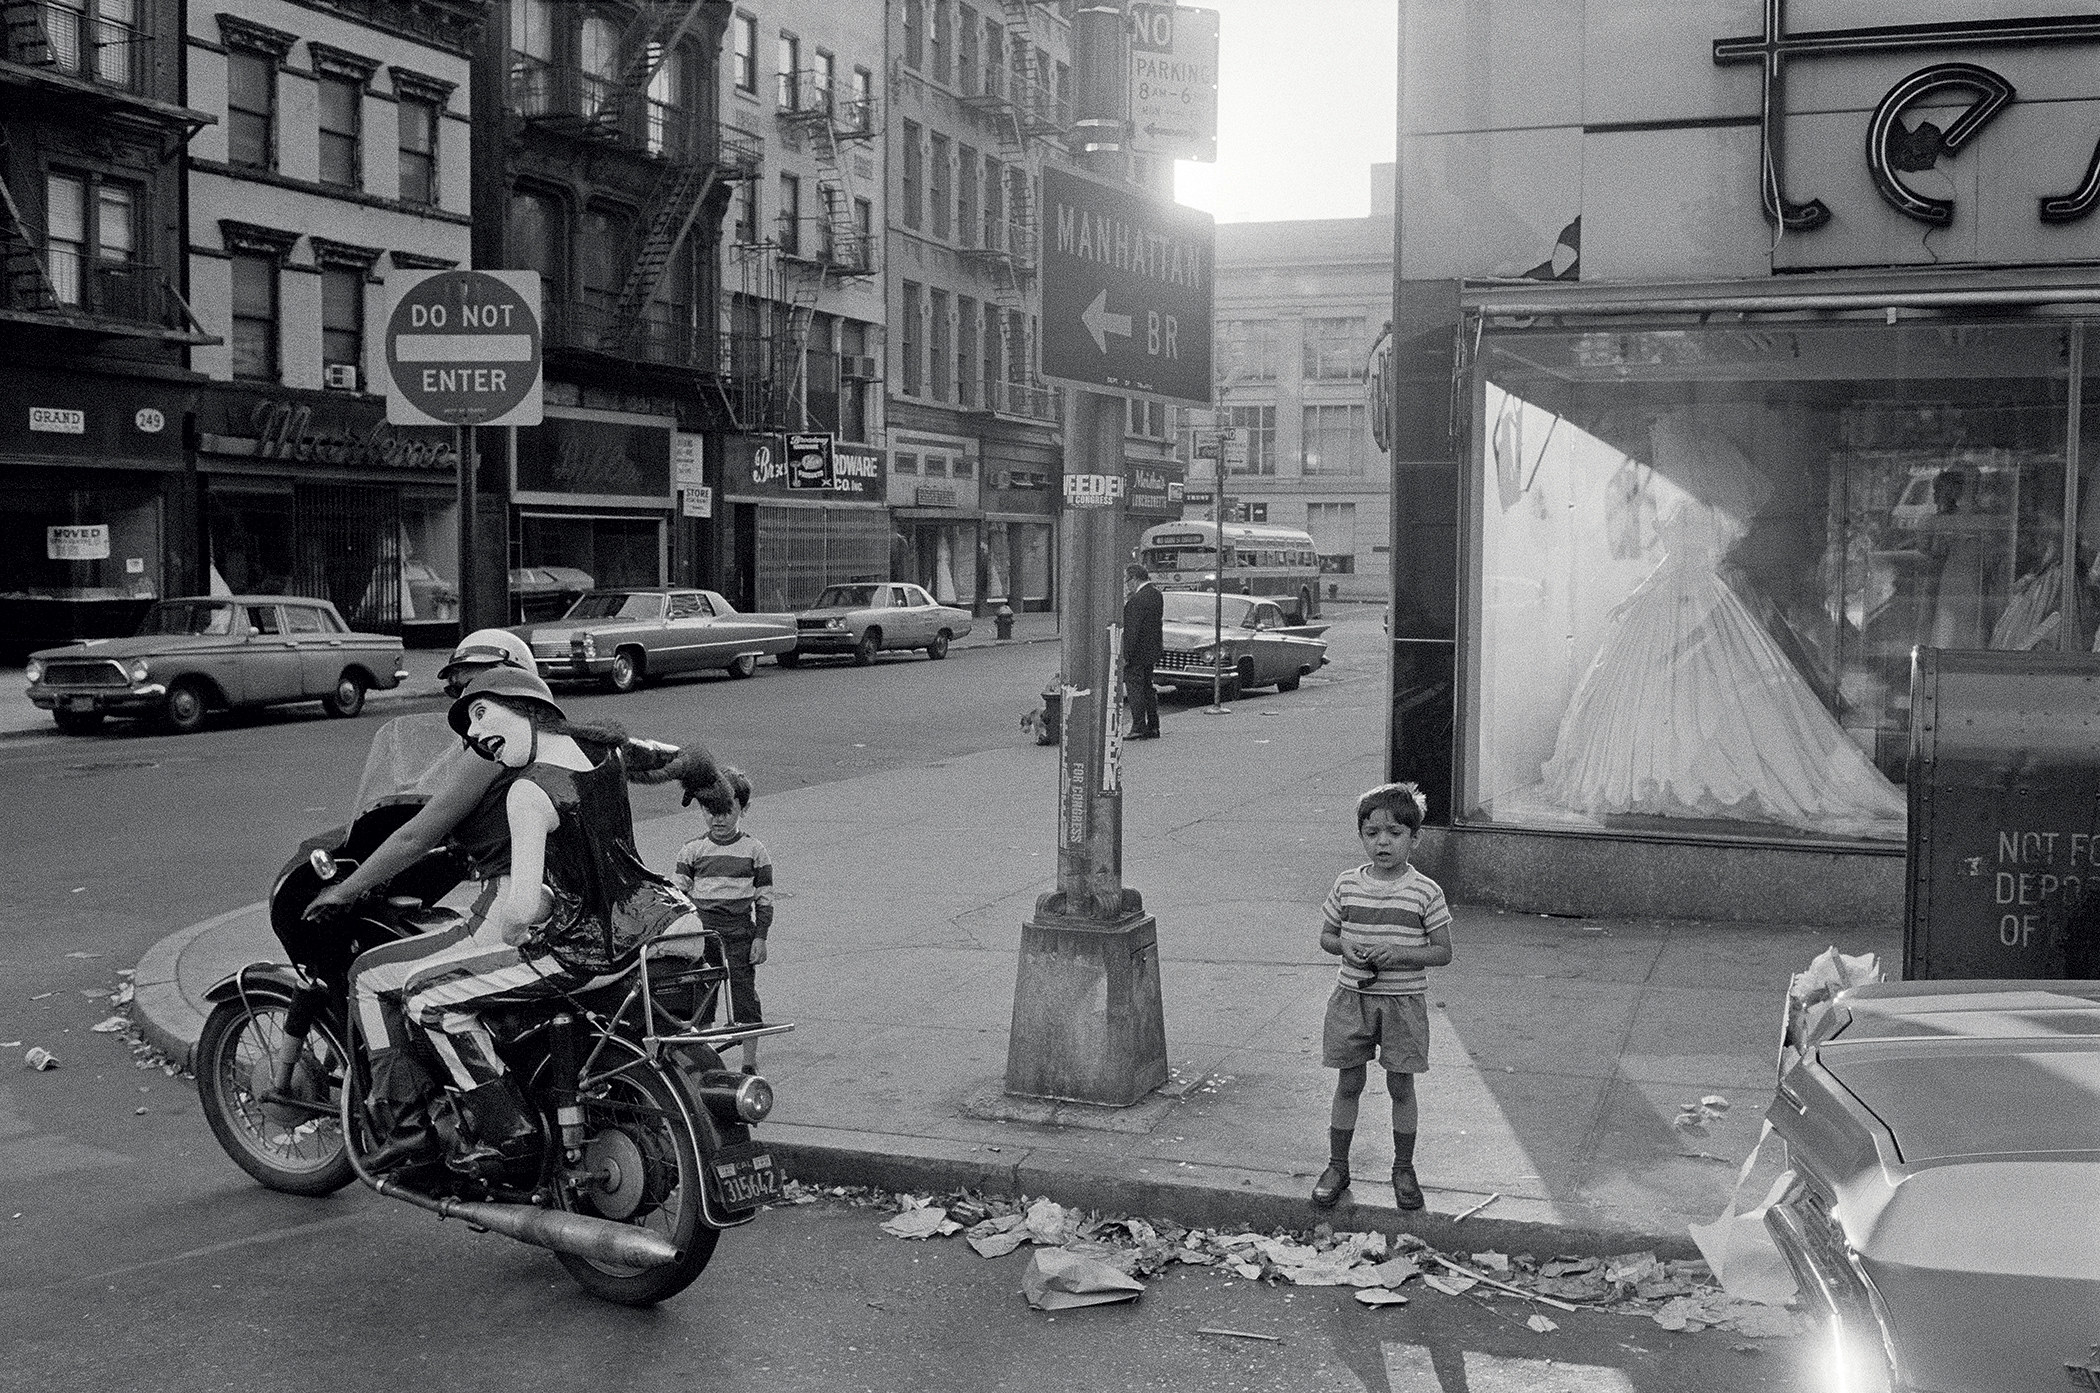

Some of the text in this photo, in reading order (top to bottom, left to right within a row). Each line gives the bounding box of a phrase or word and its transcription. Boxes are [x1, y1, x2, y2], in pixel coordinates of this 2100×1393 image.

[1133, 10, 1172, 46] NO
[1136, 58, 1210, 84] PARKING
[1057, 203, 1200, 289] MANHATTAN
[411, 304, 514, 328] DO NOT
[1147, 310, 1178, 360] BR
[422, 369, 507, 392] ENTER
[33, 410, 81, 424] GRAND
[139, 412, 161, 428] 249
[686, 488, 709, 498] STORE
[1075, 495, 1113, 505] CONGRESS
[54, 529, 101, 538] MOVED
[1071, 763, 1084, 843] FOR CONGRESS
[1999, 831, 2059, 865] NOT
[2000, 914, 2040, 948] OF
[723, 1170, 778, 1203] 315642
